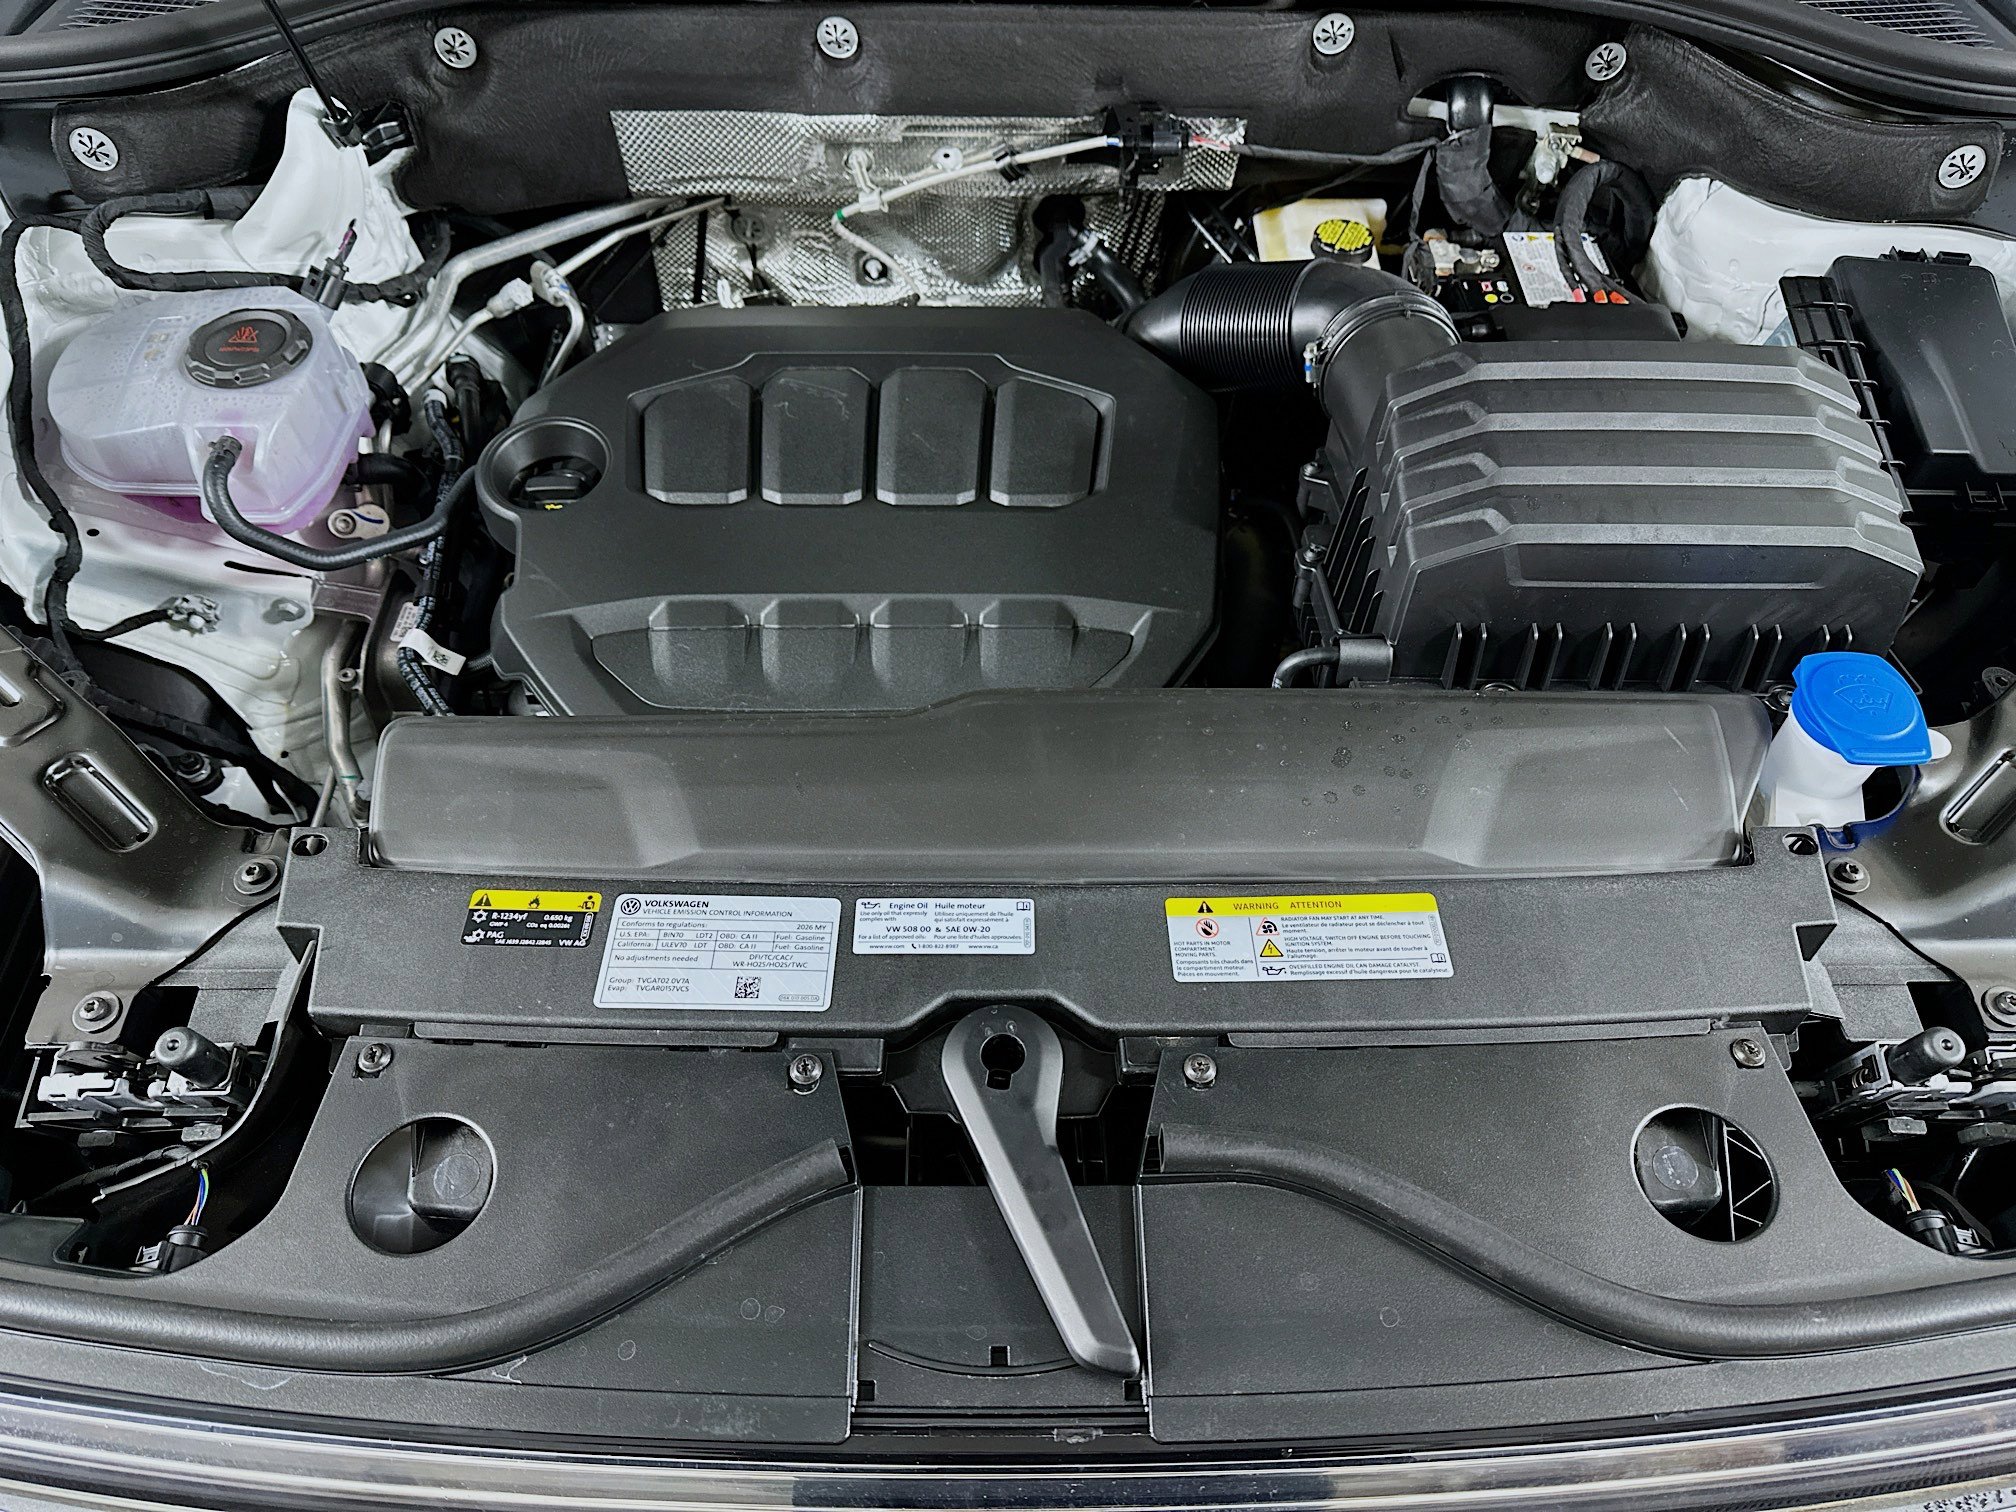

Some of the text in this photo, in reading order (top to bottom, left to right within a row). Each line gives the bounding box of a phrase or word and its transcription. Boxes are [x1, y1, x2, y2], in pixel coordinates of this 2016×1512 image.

[645, 900, 709, 908] VOLKSWAGEN
[889, 902, 915, 910] Engine
[1233, 901, 1342, 910] WARNING ATTENTION
[492, 912, 528, 921] R-1234yf
[564, 914, 573, 923] kg
[666, 921, 707, 929] regulations:
[486, 931, 504, 939] PAG
[626, 955, 670, 963] adjustments
